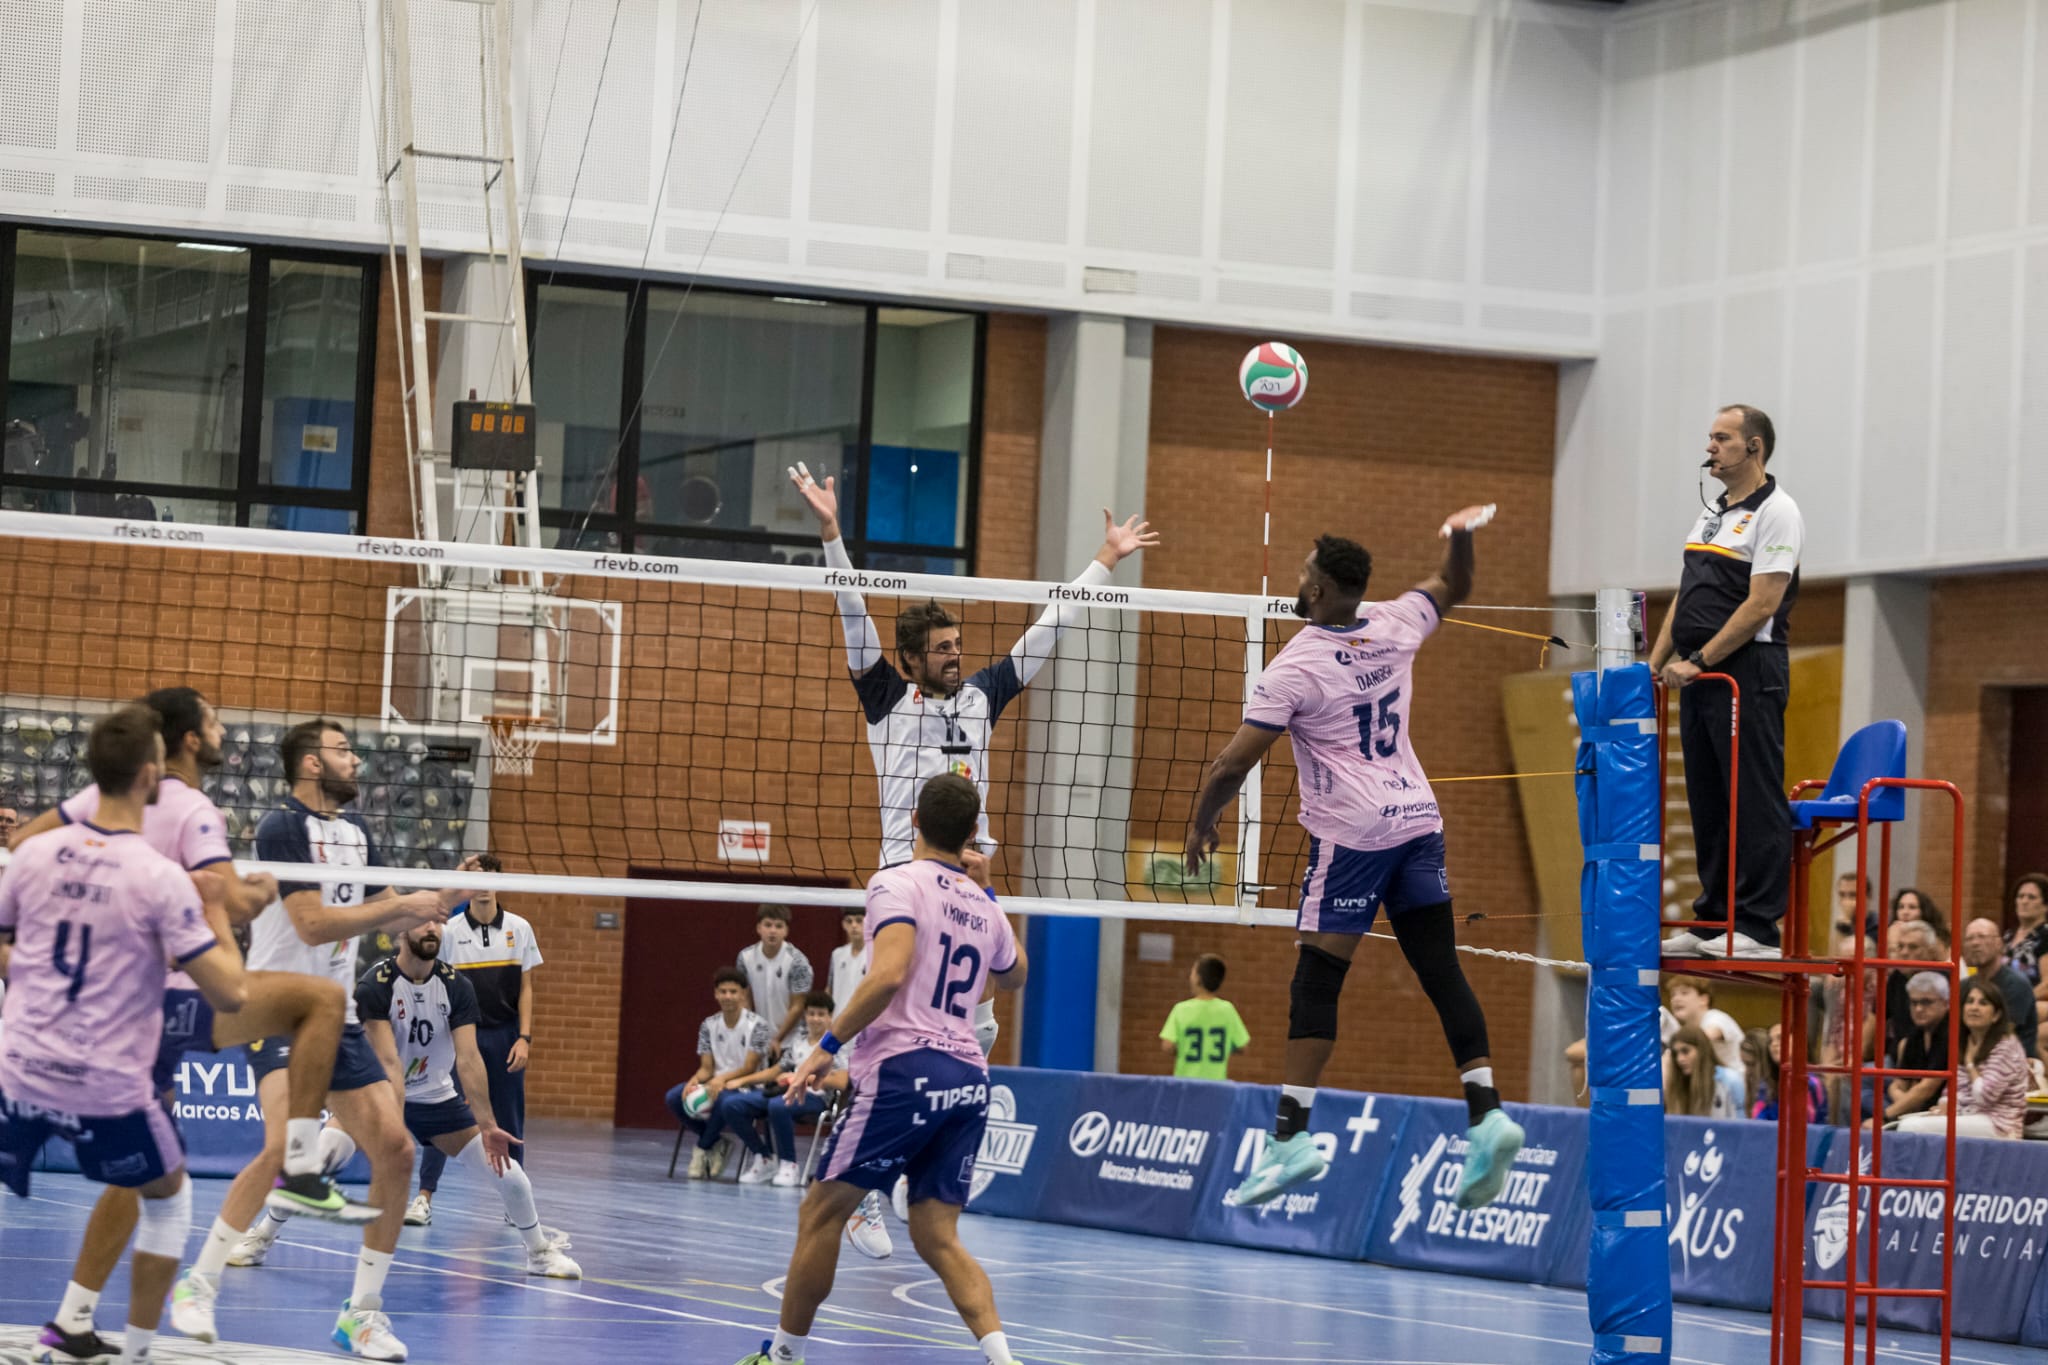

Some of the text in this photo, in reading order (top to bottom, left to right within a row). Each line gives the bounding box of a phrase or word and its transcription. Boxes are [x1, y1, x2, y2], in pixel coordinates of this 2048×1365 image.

[113, 523, 205, 542] rfevb.com
[357, 540, 445, 558] rfevb.com
[593, 557, 679, 575] rfevb.com
[824, 571, 907, 589] rfevb.com
[1048, 585, 1129, 603] rfevb.com
[1352, 686, 1401, 761] 15
[53, 920, 93, 1002] 4
[930, 931, 981, 1019] 12
[408, 1016, 434, 1048] 10
[1184, 1026, 1227, 1063] 33
[925, 1083, 988, 1112] TIPSA
[1107, 1120, 1210, 1166] HYUNDAI
[1098, 1159, 1137, 1183] Marcos
[1284, 1191, 1320, 1221] sport
[1426, 1200, 1551, 1247] DE L'ESPORT
[1878, 1228, 2035, 1262] ALENCIA
